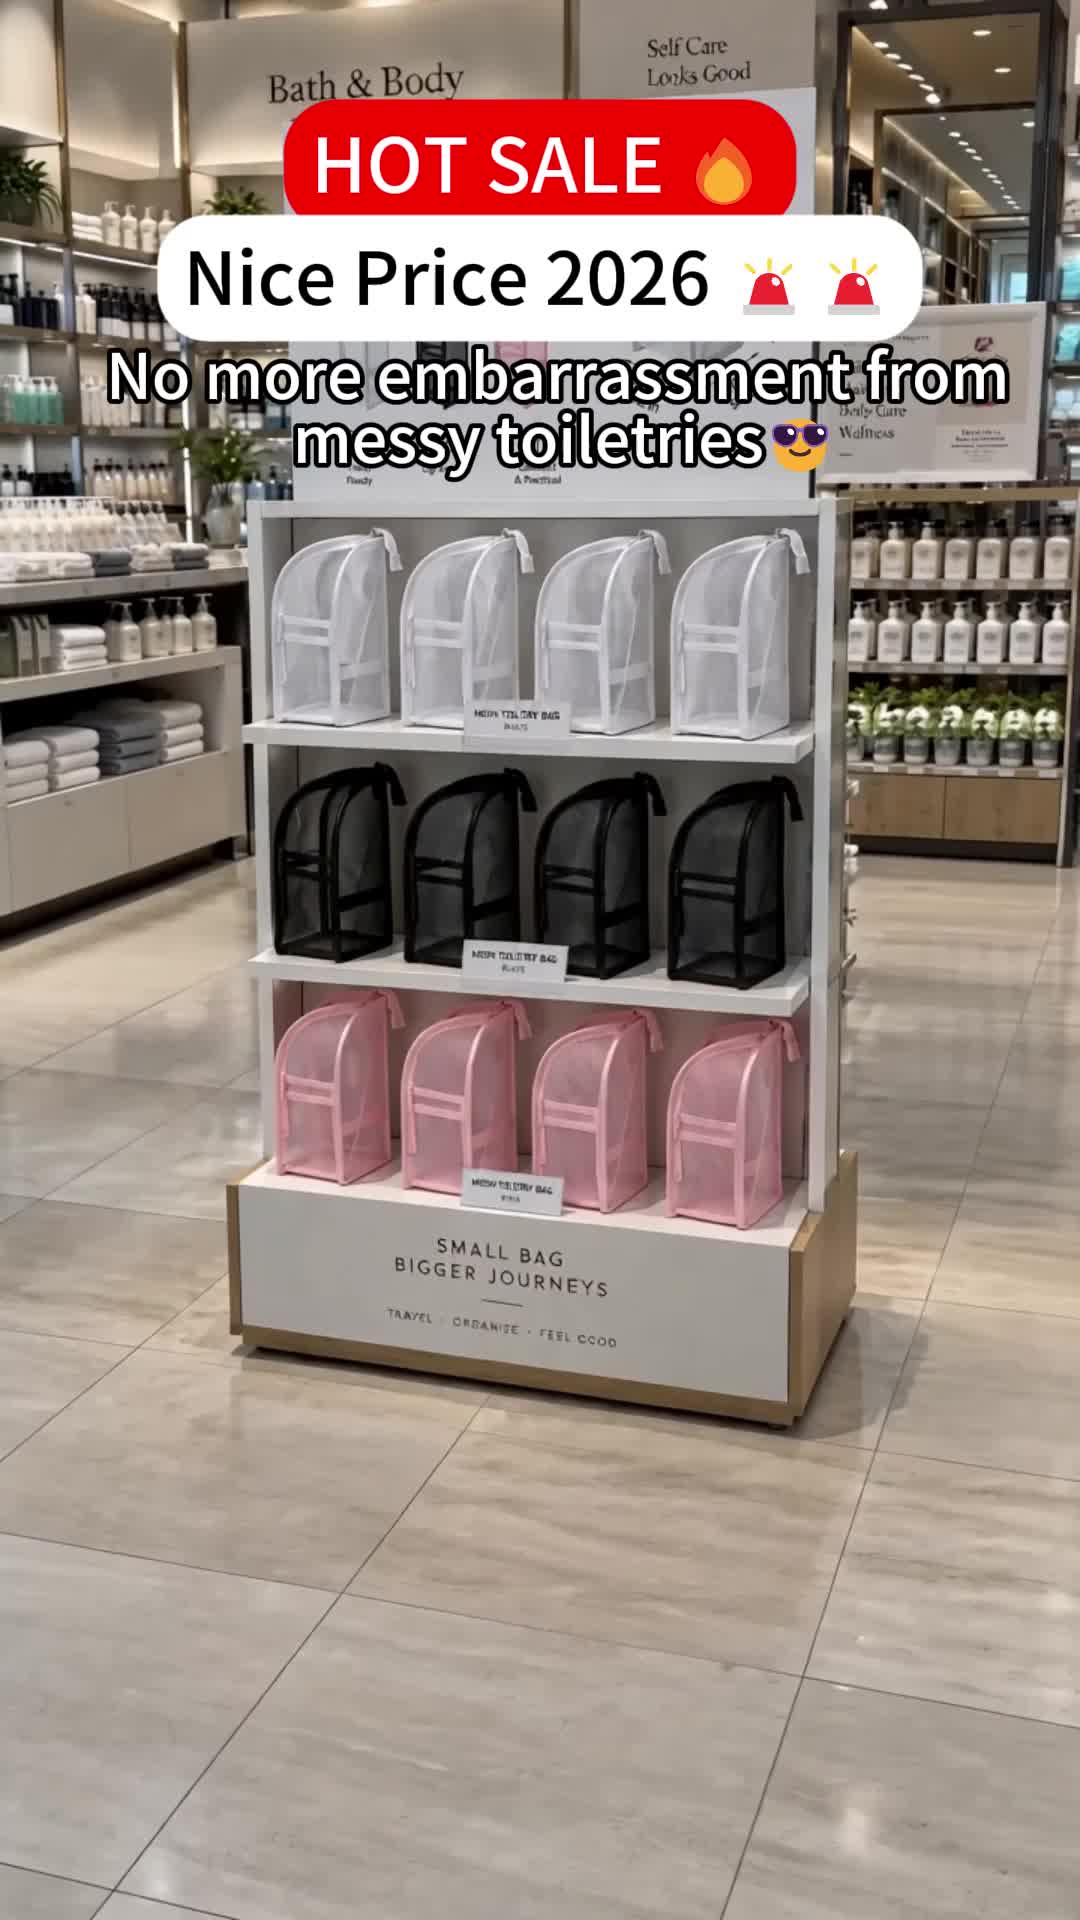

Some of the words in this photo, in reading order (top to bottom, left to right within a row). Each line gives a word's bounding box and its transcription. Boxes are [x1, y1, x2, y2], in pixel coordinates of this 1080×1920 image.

[646, 36, 684, 58] Self
[685, 35, 728, 56] Care
[267, 69, 337, 104] Bath
[346, 67, 374, 99] &
[380, 61, 464, 100] Body
[702, 60, 752, 83] Good
[436, 1237, 510, 1261] SMALL
[519, 1247, 564, 1268] BAG
[394, 1256, 477, 1281] BIGGER
[487, 1267, 609, 1298] JOURNEYS
